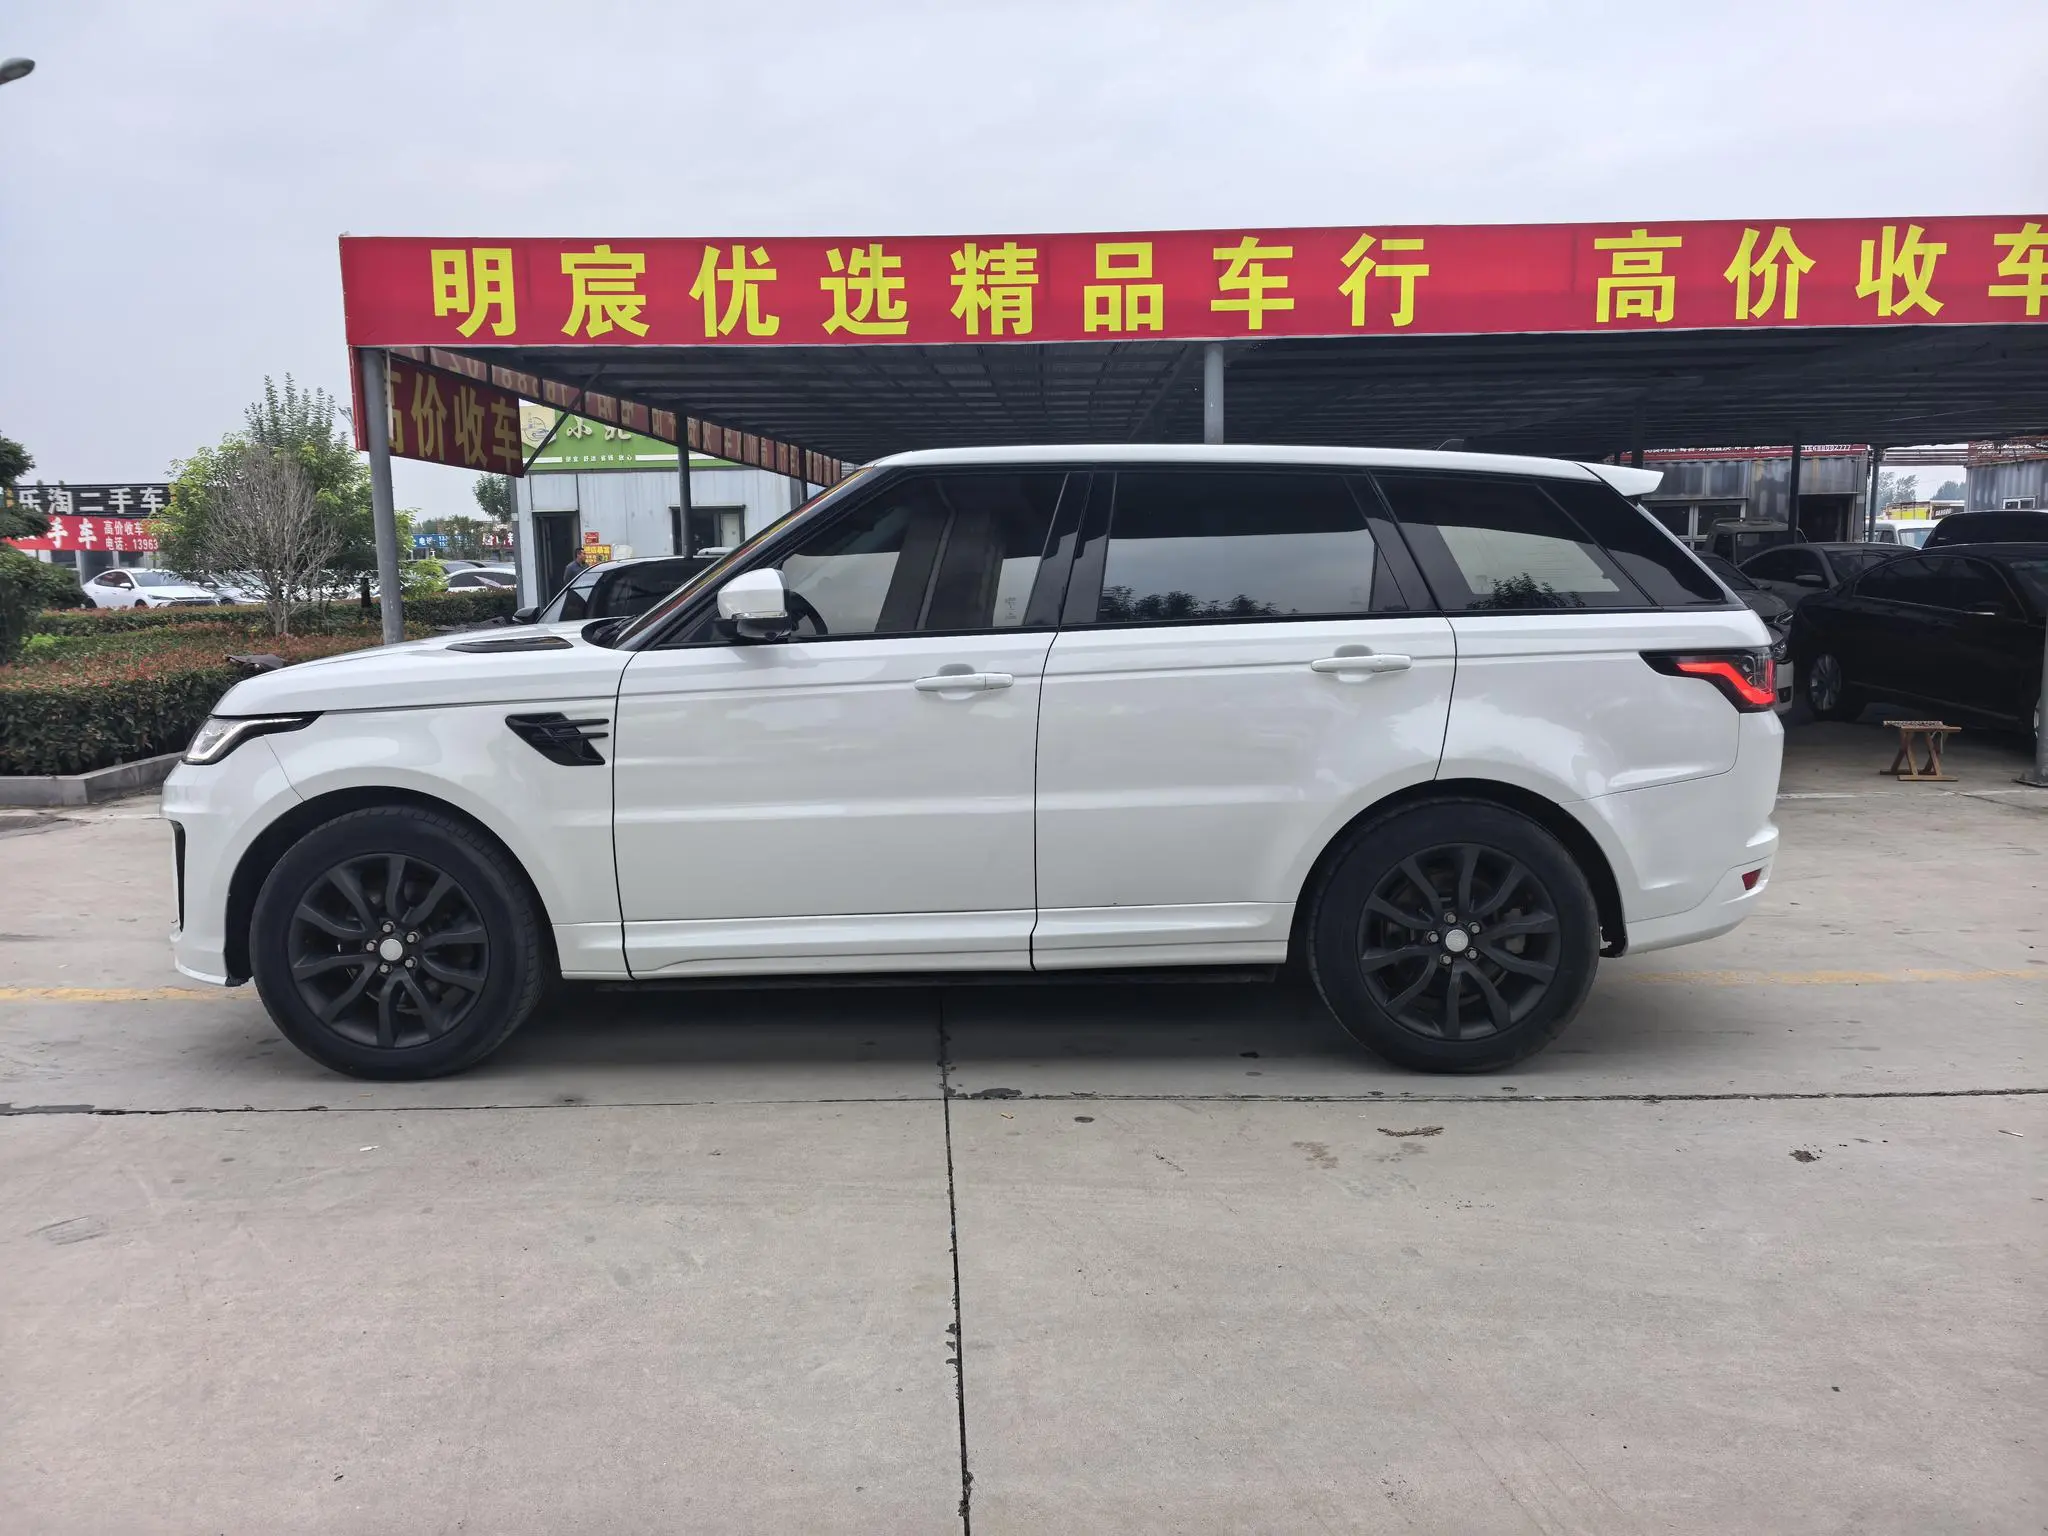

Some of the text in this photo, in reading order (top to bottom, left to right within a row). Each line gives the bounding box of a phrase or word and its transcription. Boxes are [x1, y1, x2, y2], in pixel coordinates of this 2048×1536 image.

[430, 225, 2047, 338] 明宸优选精品车行 高价收车
[103, 520, 144, 535] 高价收车
